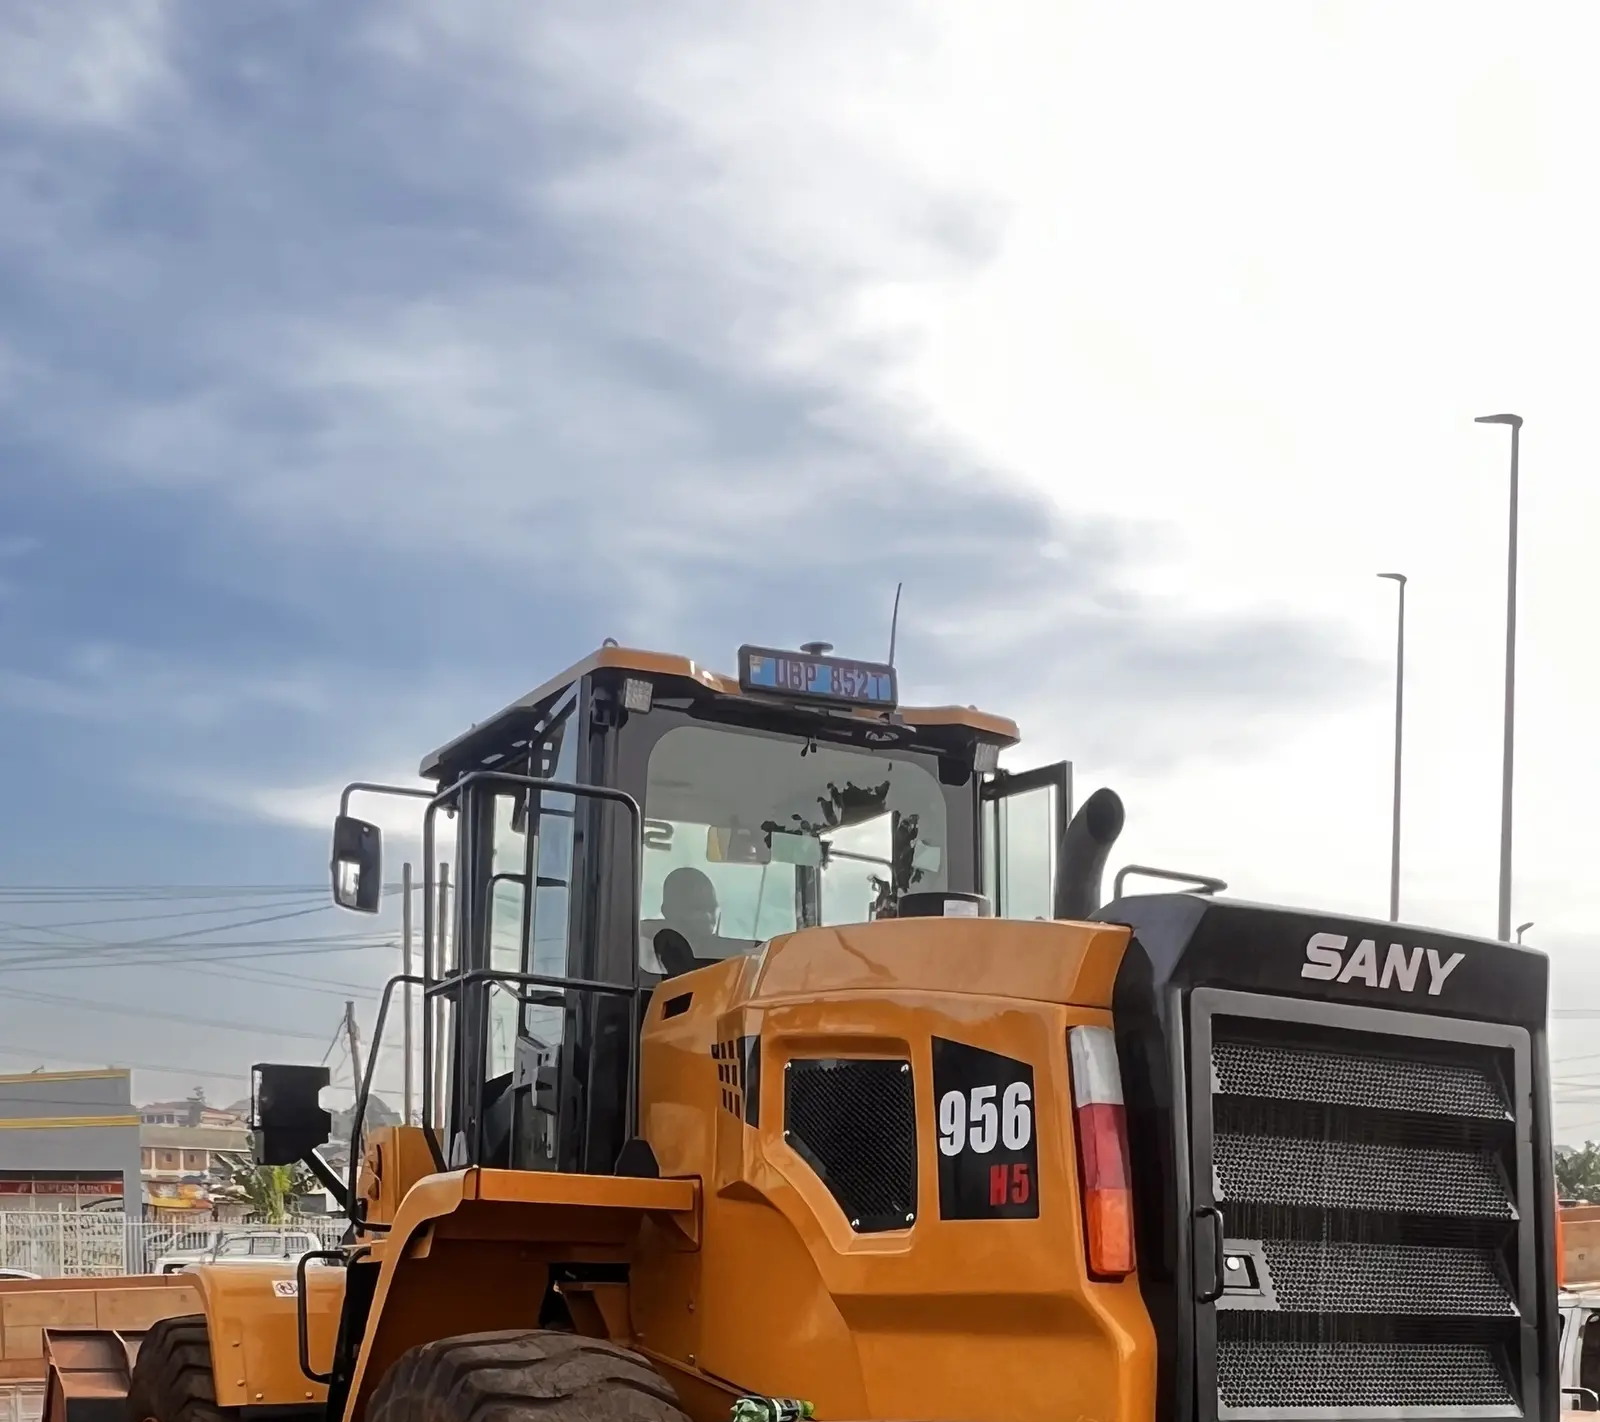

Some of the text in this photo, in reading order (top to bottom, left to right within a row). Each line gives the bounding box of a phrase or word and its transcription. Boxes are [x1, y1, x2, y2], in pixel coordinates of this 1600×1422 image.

[776, 658, 884, 700] UBP 852T
[1301, 932, 1466, 996] SANY
[939, 1081, 1032, 1157] 956
[989, 1163, 1030, 1206] H5
